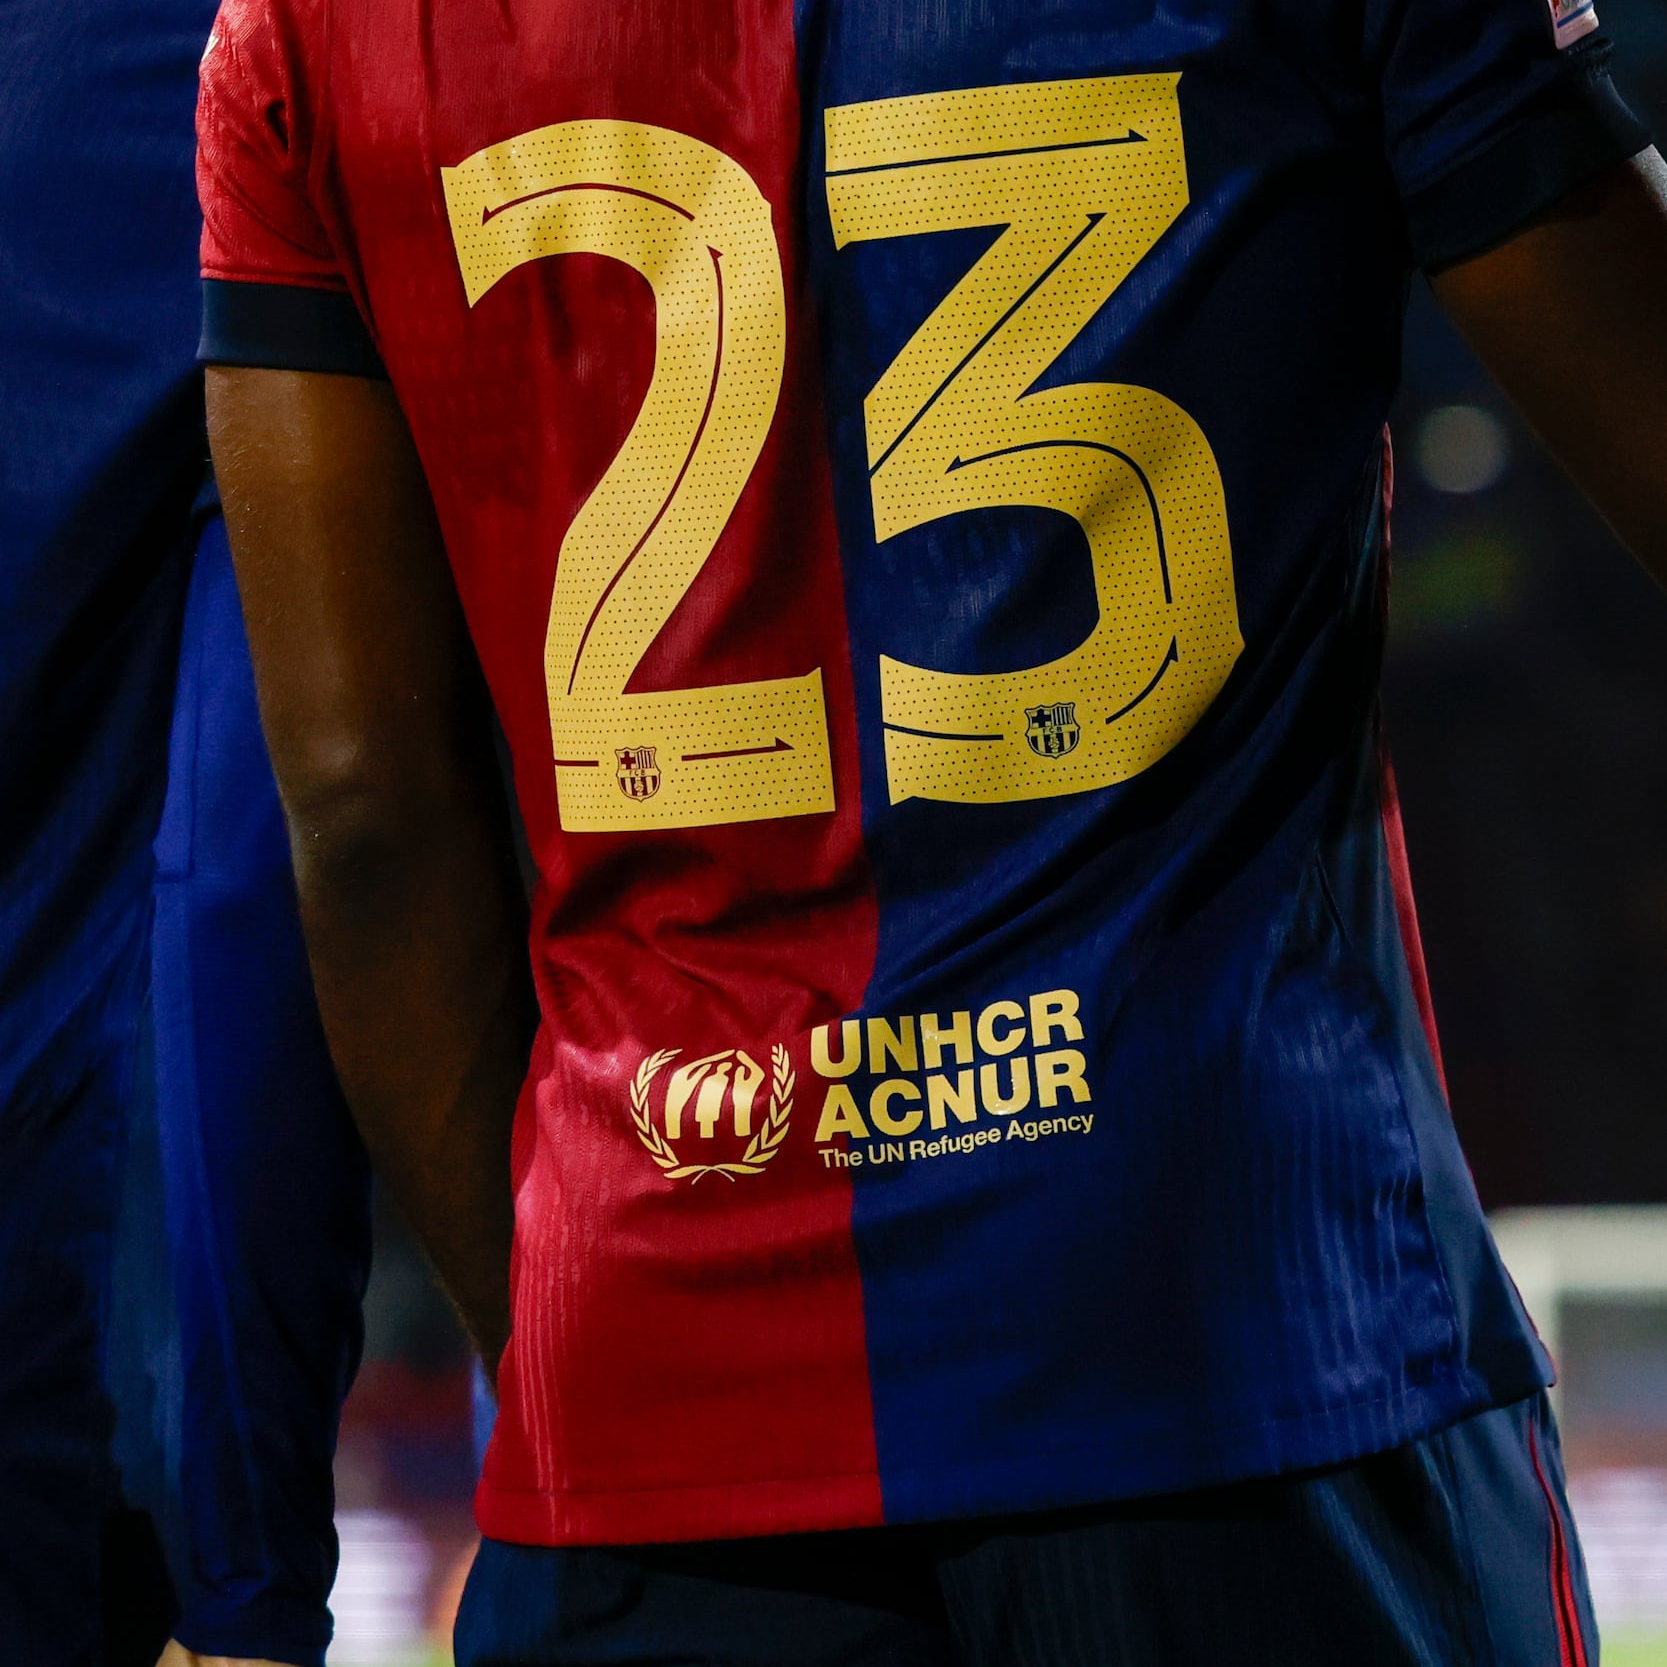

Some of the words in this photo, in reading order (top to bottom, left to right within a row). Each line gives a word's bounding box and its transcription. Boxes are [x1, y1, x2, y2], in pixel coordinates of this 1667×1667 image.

[441, 72, 1245, 832] 23
[810, 989, 1085, 1079] UNHCR
[814, 1048, 1092, 1143] ACNUR
[818, 1148, 863, 1169] The
[868, 1142, 904, 1164] UN
[909, 1127, 1001, 1161] Refugee
[1006, 1114, 1095, 1142] Agency
